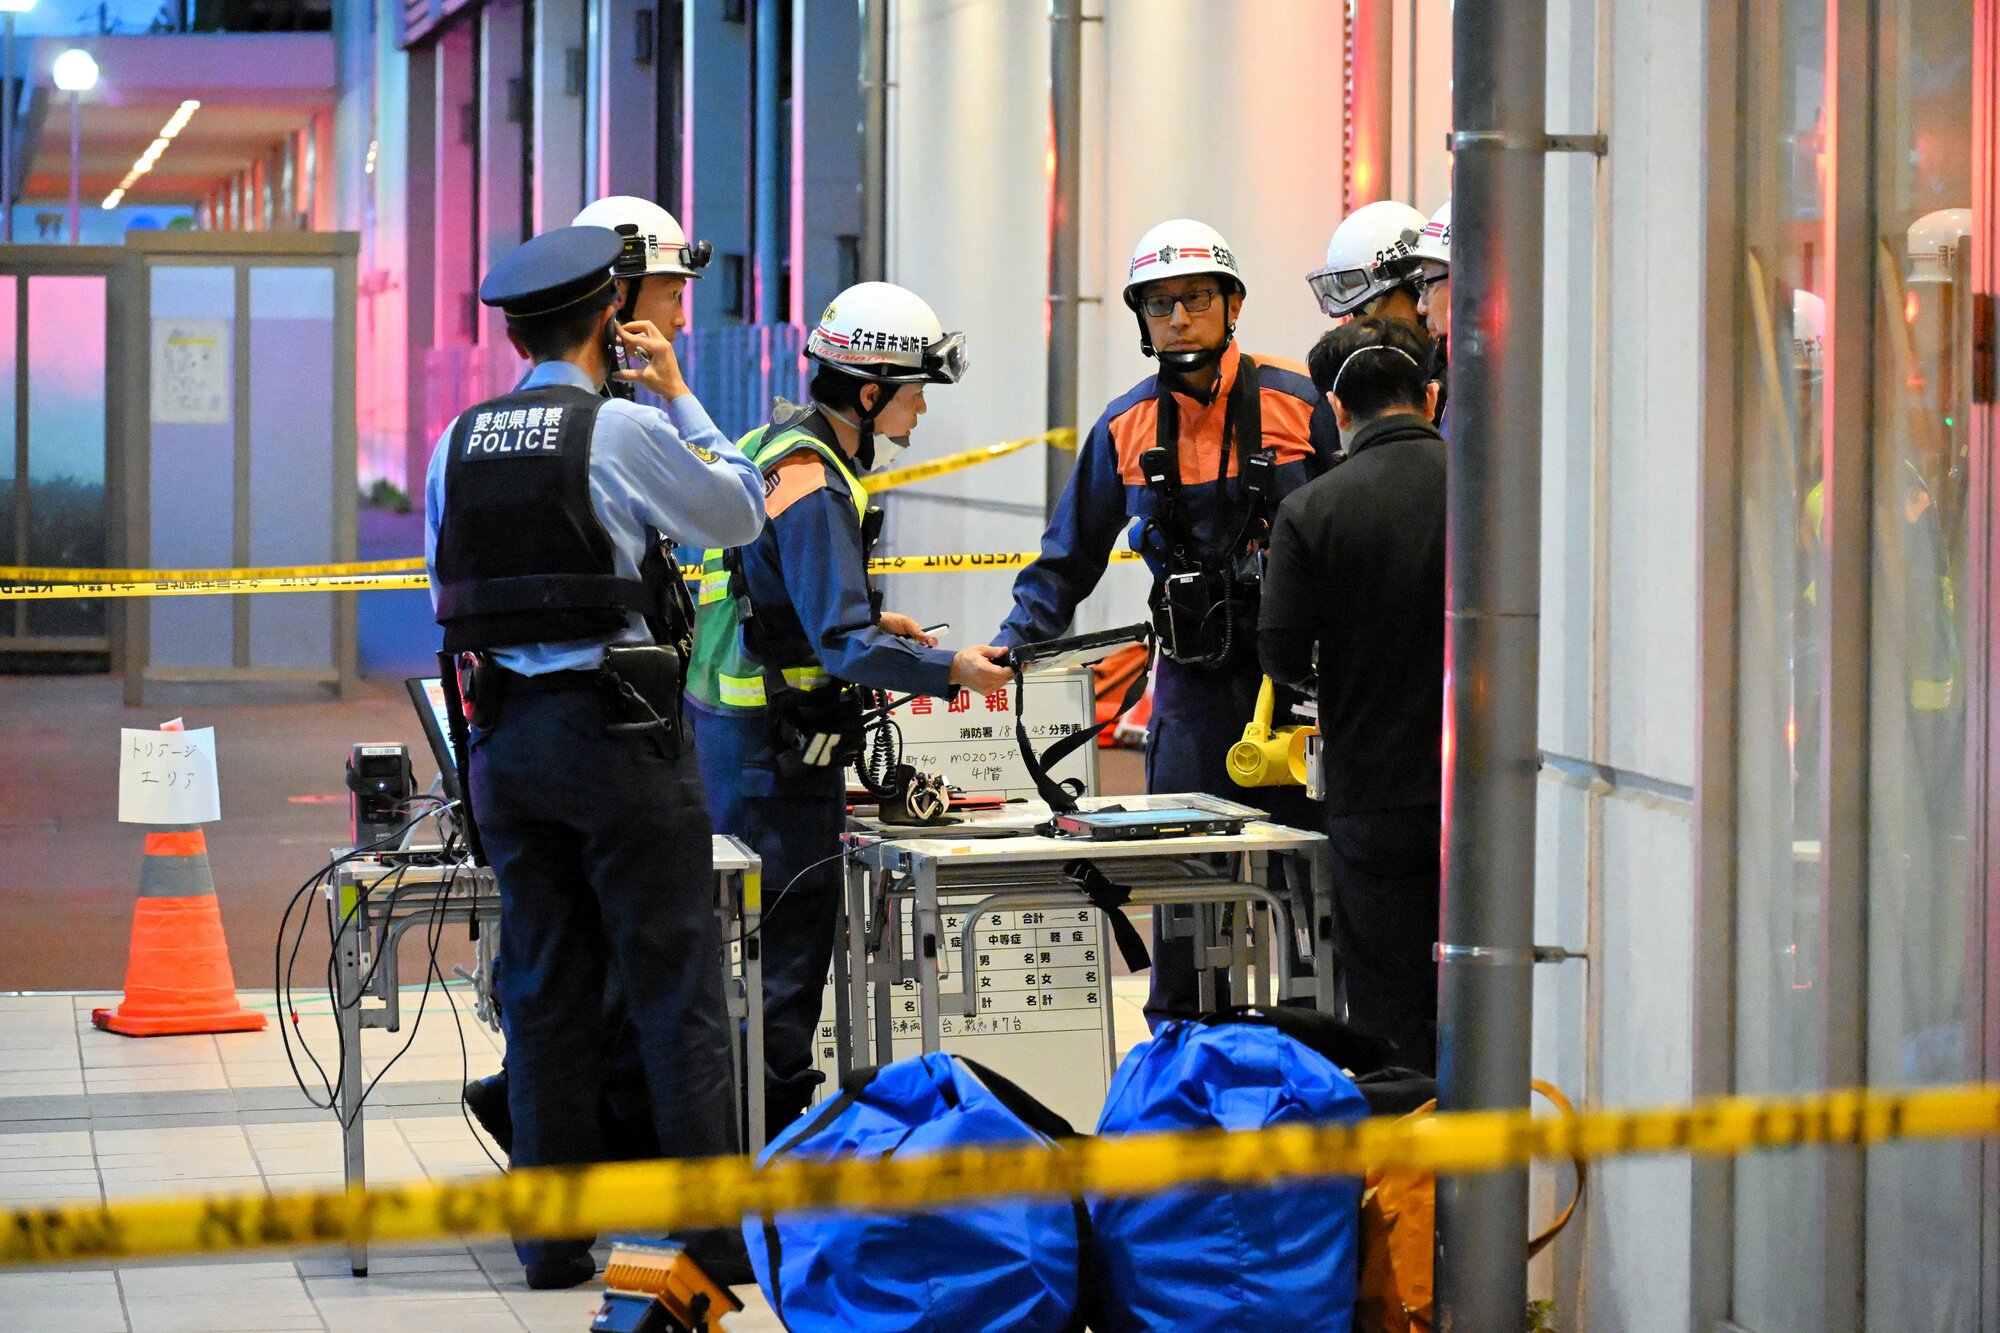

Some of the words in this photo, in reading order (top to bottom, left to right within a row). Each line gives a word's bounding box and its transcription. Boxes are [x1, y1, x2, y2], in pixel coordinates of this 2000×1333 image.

[473, 407, 563, 433] 愛知県警察
[467, 428, 559, 454] POLICE
[960, 727, 993, 739] 消防署
[133, 737, 197, 759] トリアージ
[141, 771, 195, 789] エリア
[946, 916, 957, 928] 女
[991, 915, 1002, 926] 名
[1022, 913, 1044, 924] 合計
[1078, 911, 1089, 922] 名
[988, 934, 1021, 946] 中等症
[979, 955, 990, 966] 男
[1024, 953, 1035, 964] 名
[1040, 952, 1051, 964] 男
[1084, 950, 1096, 962] 名
[903, 979, 915, 991] 名
[980, 976, 992, 988] 女
[1025, 974, 1036, 986] 名
[1041, 973, 1052, 985] 女
[1086, 971, 1097, 983] 名
[904, 1001, 916, 1012] 名
[981, 996, 993, 1009] 計
[1026, 995, 1037, 1007] 名
[1042, 994, 1053, 1007] 計
[1087, 992, 1098, 1004] 名
[821, 1026, 836, 1038] 出
